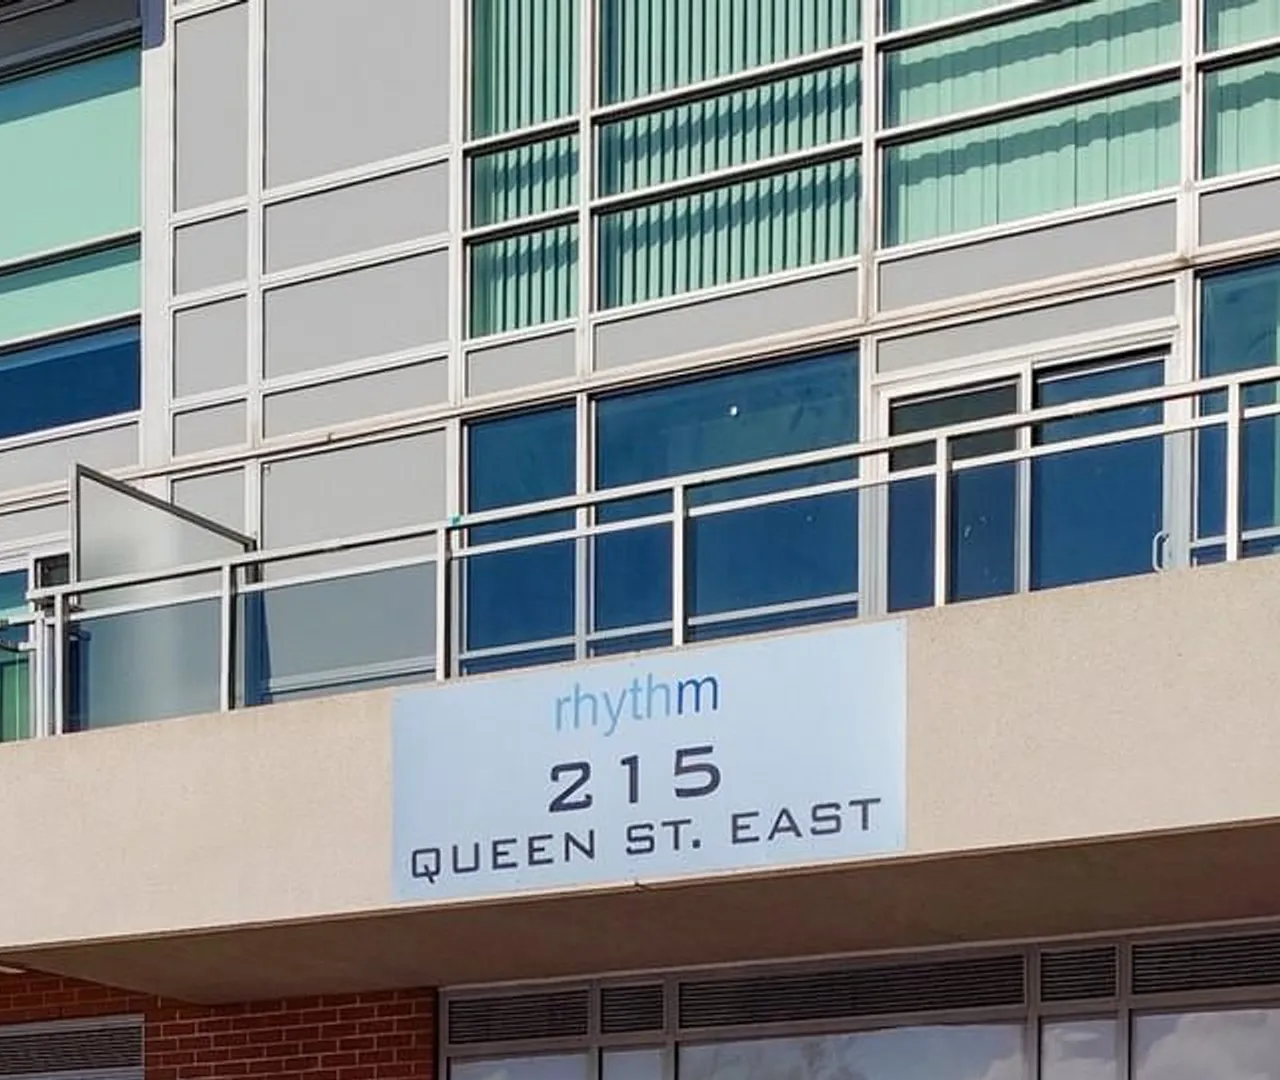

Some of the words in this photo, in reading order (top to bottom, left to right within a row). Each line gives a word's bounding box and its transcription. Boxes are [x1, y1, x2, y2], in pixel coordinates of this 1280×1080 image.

[554, 672, 719, 737] rhythm
[548, 745, 722, 813] 215
[410, 828, 597, 884] QUEEN
[625, 818, 701, 856] ST.
[730, 797, 882, 845] EAST
